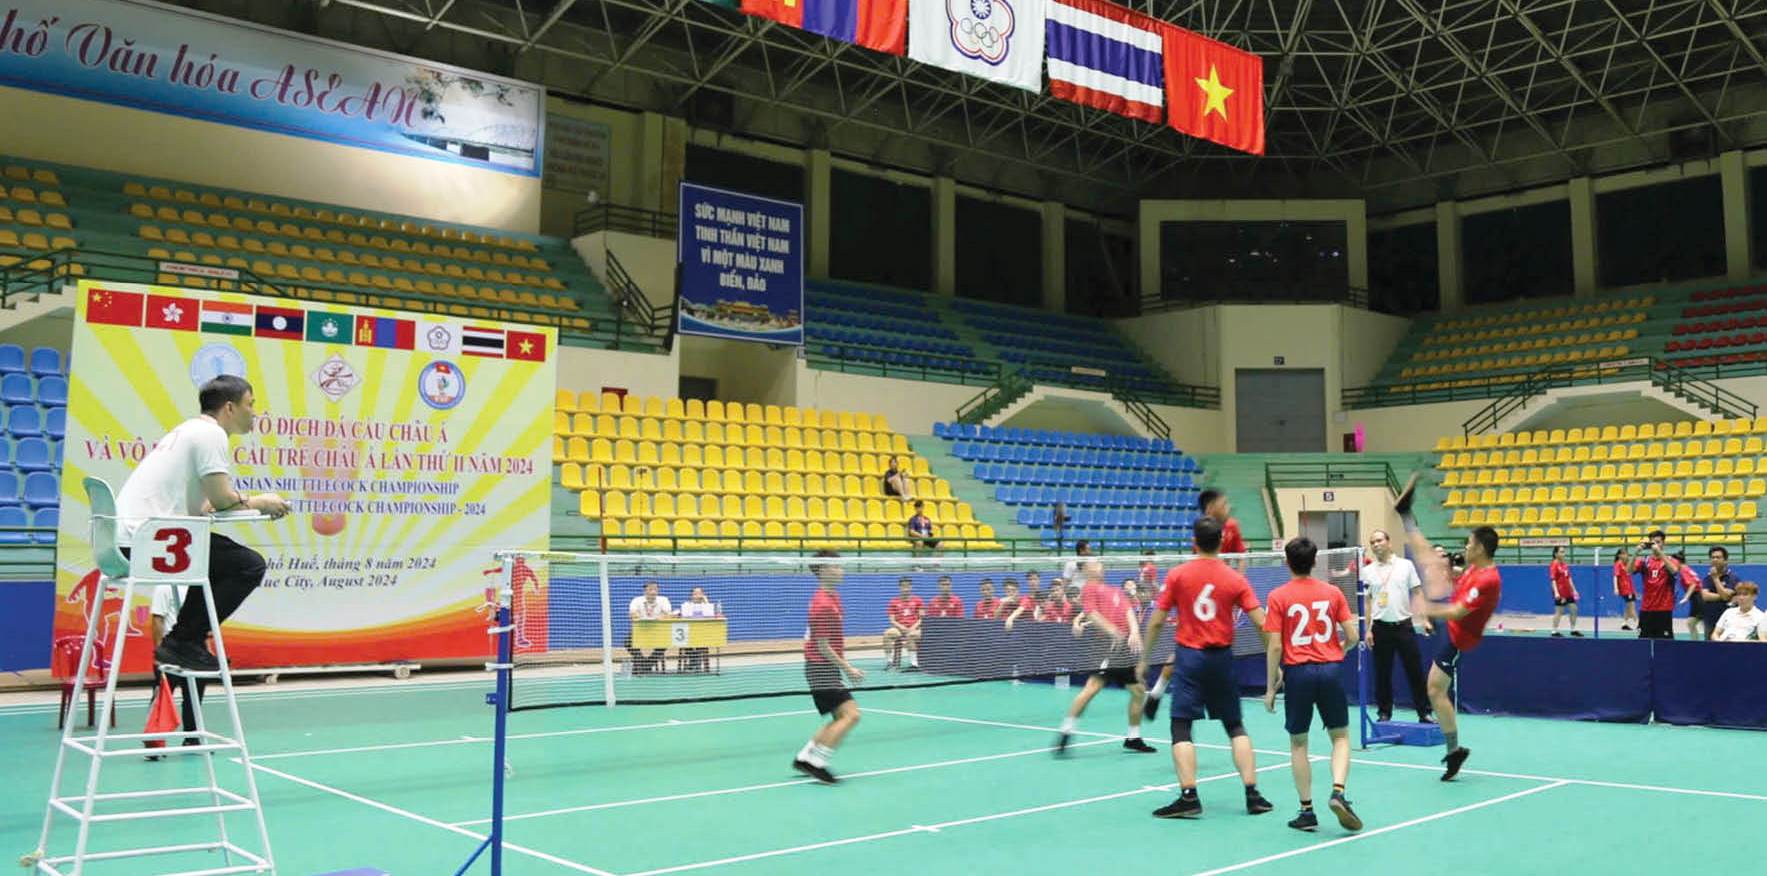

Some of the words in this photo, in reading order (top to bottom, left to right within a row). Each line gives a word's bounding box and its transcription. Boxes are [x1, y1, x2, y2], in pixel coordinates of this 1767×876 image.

[65, 23, 158, 79] Văn
[170, 43, 240, 93] hóa
[250, 63, 420, 128] ASEAN
[694, 202, 715, 220] SỨC
[717, 207, 745, 226] MẠNH
[747, 211, 766, 231] VIỆT
[768, 217, 790, 232] NAM
[695, 226, 717, 241] TINH
[720, 227, 745, 246] THẦN
[746, 233, 766, 252] VIỆT
[768, 239, 789, 253] NAM
[701, 247, 711, 263] VÌ
[713, 249, 733, 268] MỘT
[736, 252, 757, 269] MÀU
[759, 257, 784, 273] XANH
[389, 419, 432, 442] CHÂU
[439, 421, 449, 443] Á
[118, 436, 146, 462] VÔ
[314, 445, 359, 469] CHÂU
[454, 454, 464, 473] II
[469, 452, 502, 473] NĂM
[506, 456, 533, 475] 2024
[234, 476, 272, 491] ASIAN
[275, 477, 368, 493] SHUTTLECOCK
[371, 478, 459, 495] CHAMPIONSHIP
[367, 500, 457, 515] CHAMPIONSHIP
[464, 502, 486, 516] 2024
[152, 527, 192, 574] 3
[324, 557, 360, 573] tháng
[376, 557, 403, 570] năm
[407, 557, 436, 570] 2024
[285, 575, 314, 590] City,
[320, 575, 364, 590] August
[367, 574, 398, 587] 2024
[1193, 583, 1217, 622] 6
[675, 628, 685, 642] 3
[1287, 600, 1334, 647] 23
